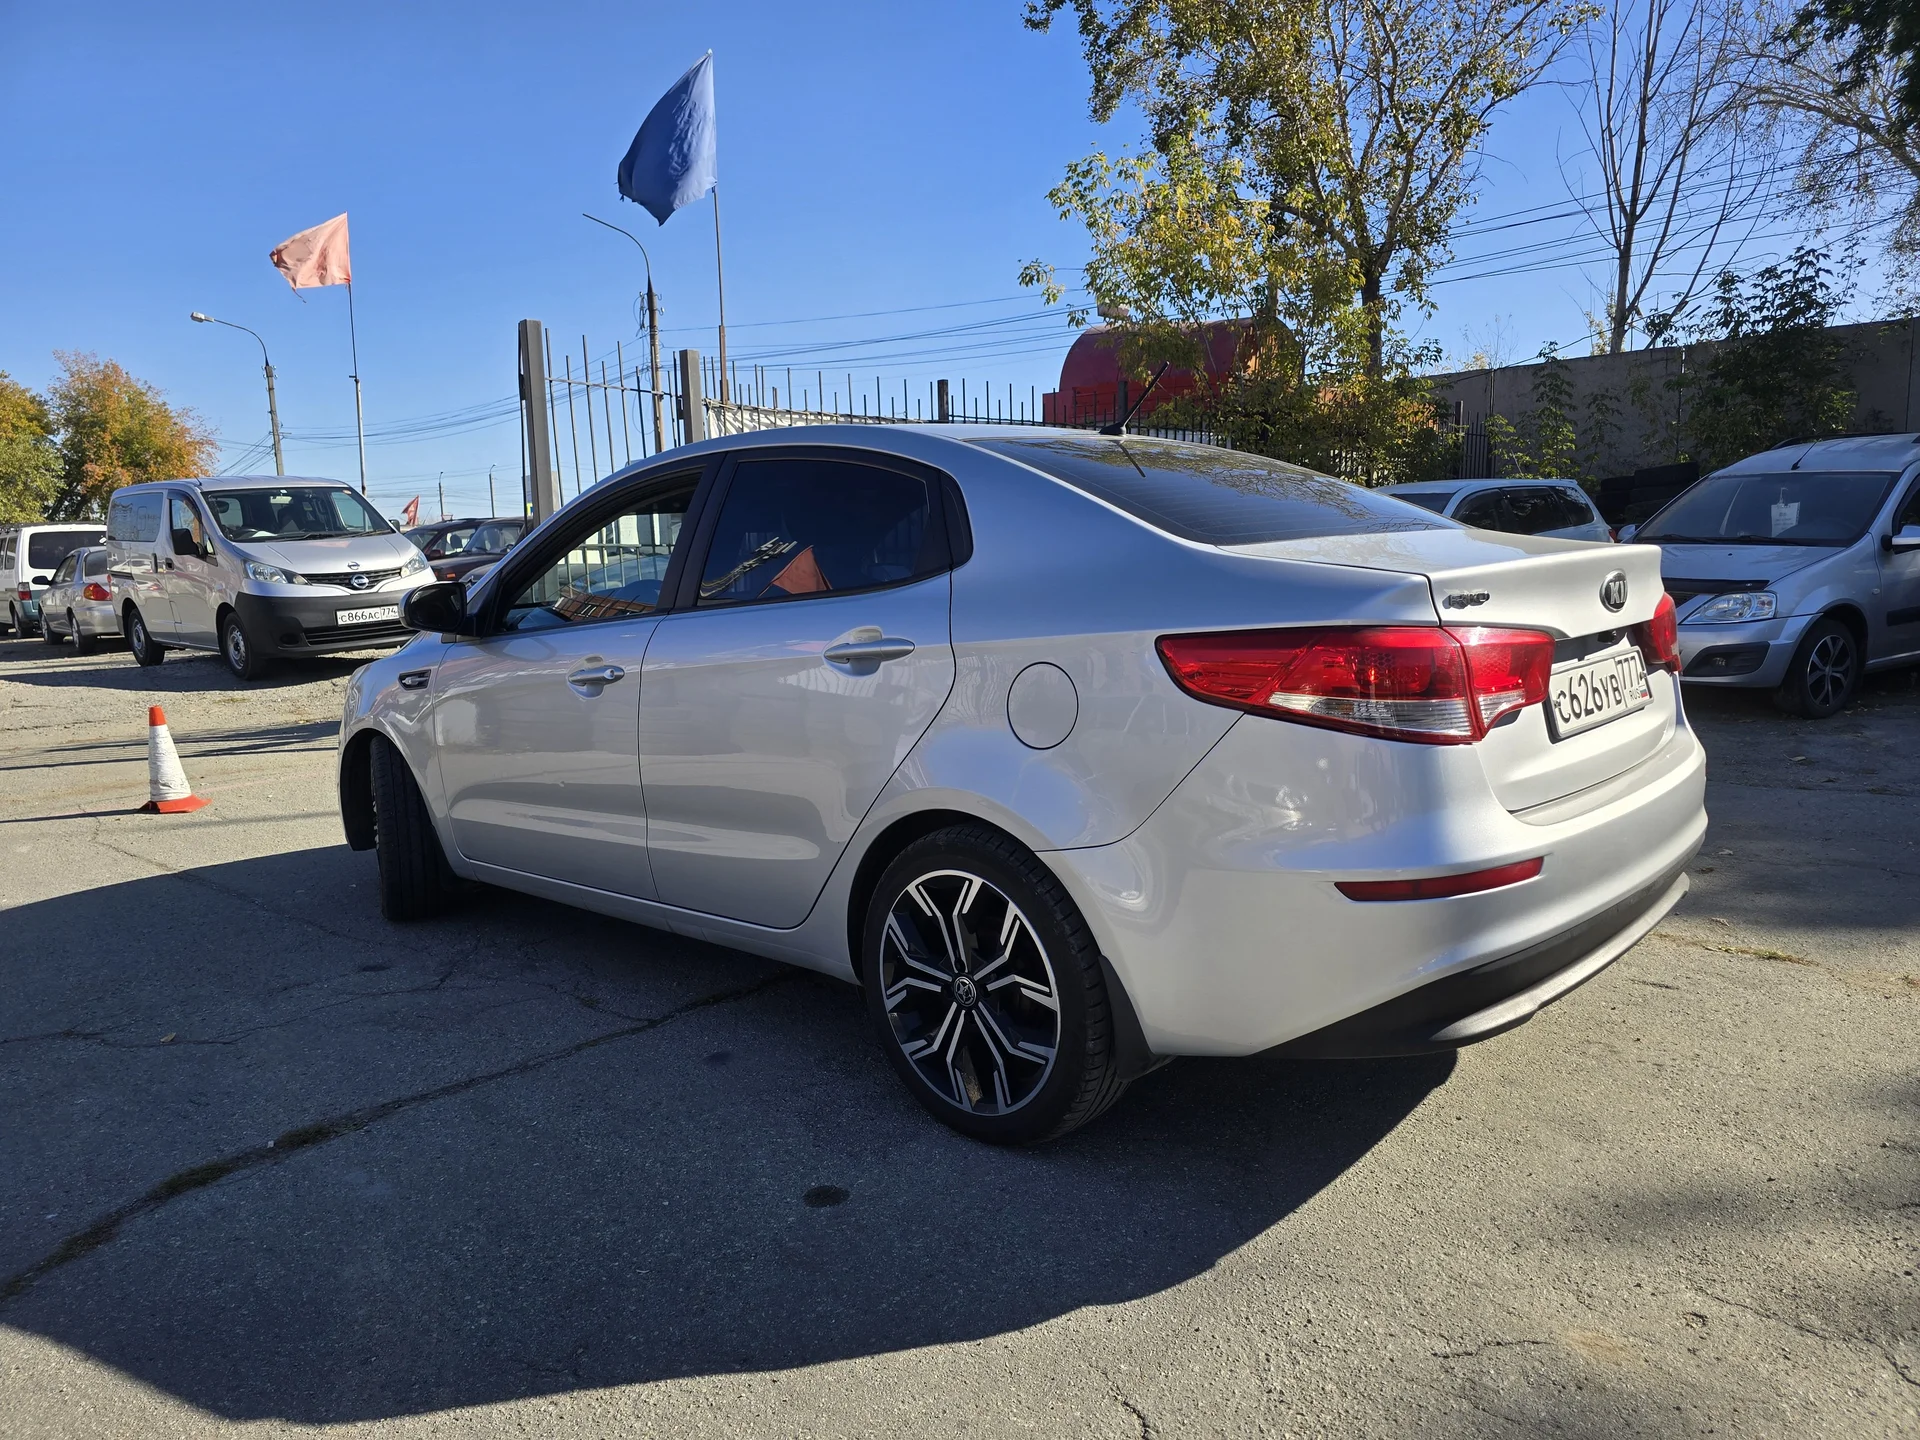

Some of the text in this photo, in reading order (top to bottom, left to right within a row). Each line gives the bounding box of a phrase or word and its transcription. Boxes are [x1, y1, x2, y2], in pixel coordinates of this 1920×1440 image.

[381, 607, 397, 616] 774
[1616, 655, 1640, 690] 777
[1629, 688, 1641, 700] RUS
